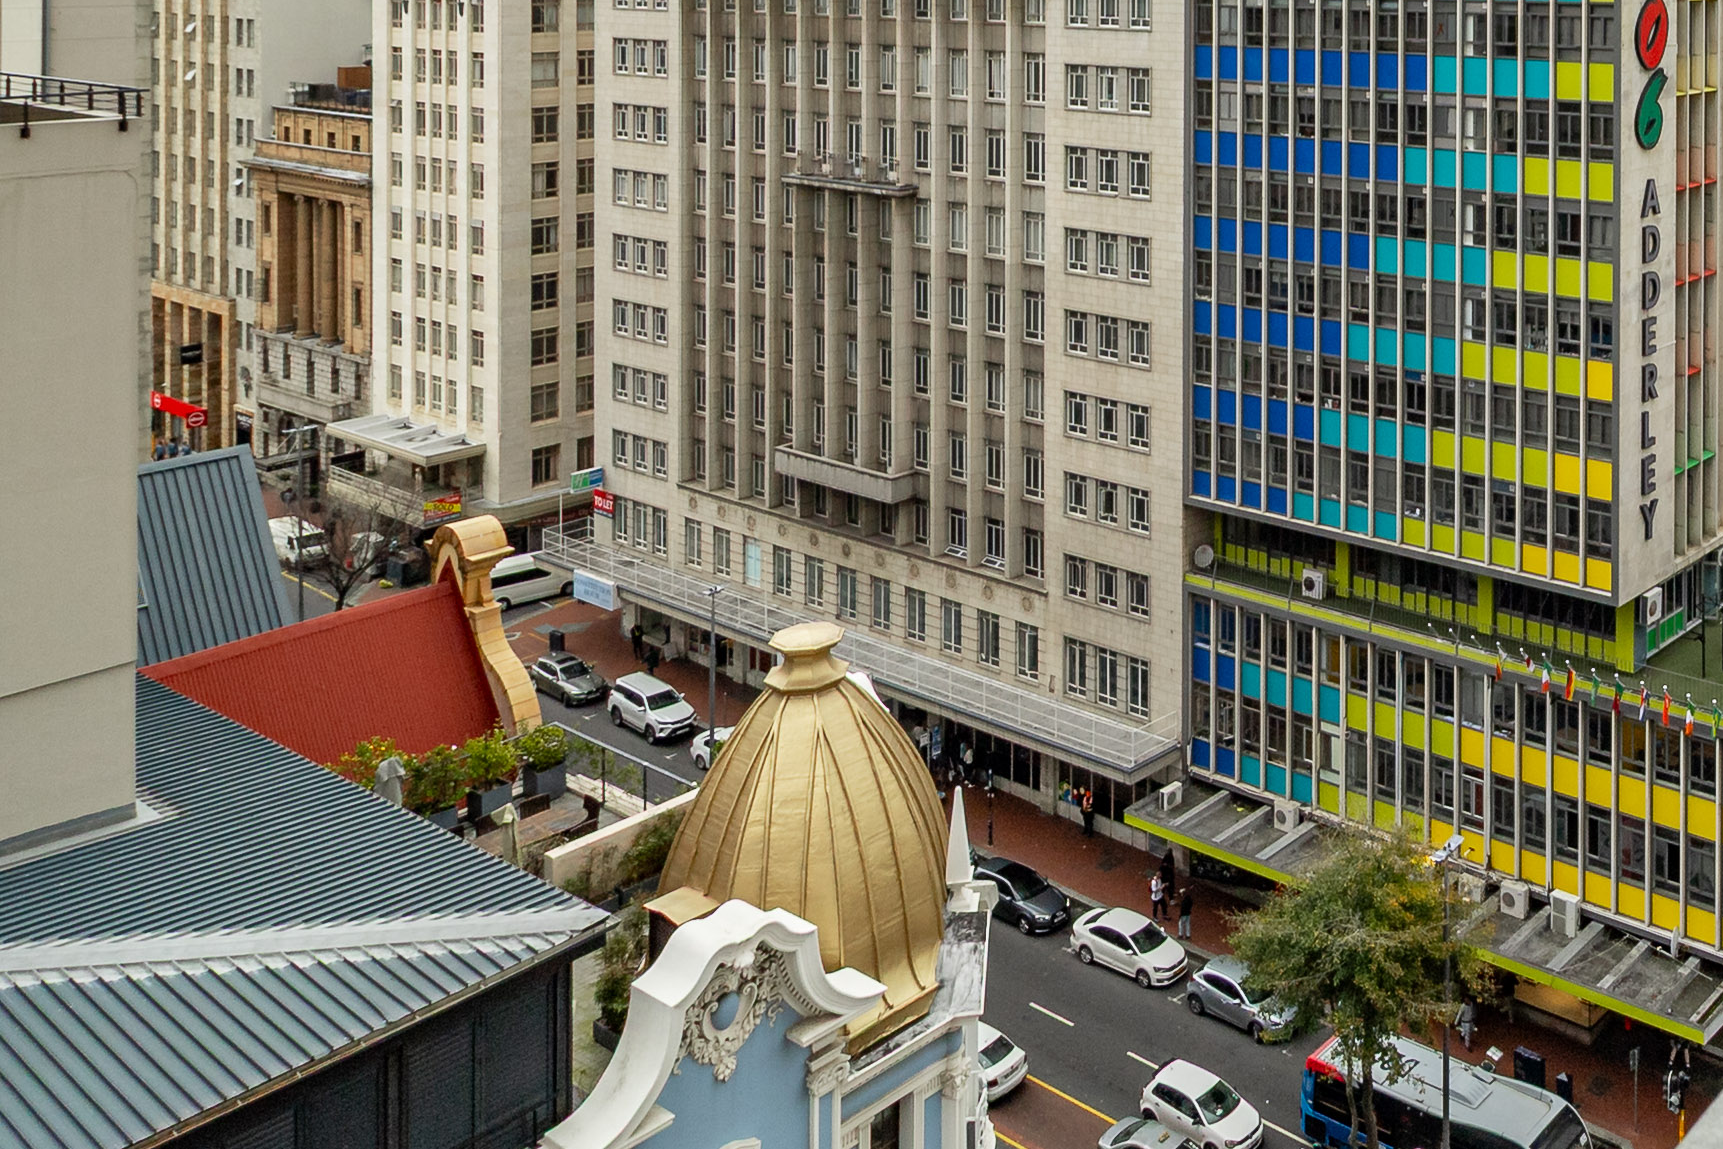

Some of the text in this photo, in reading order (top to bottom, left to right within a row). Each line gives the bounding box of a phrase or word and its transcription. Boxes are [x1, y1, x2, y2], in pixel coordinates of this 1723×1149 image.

[1639, 178, 1661, 542] ADDERLEY
[594, 495, 603, 507] TO
[603, 498, 613, 510] LET
